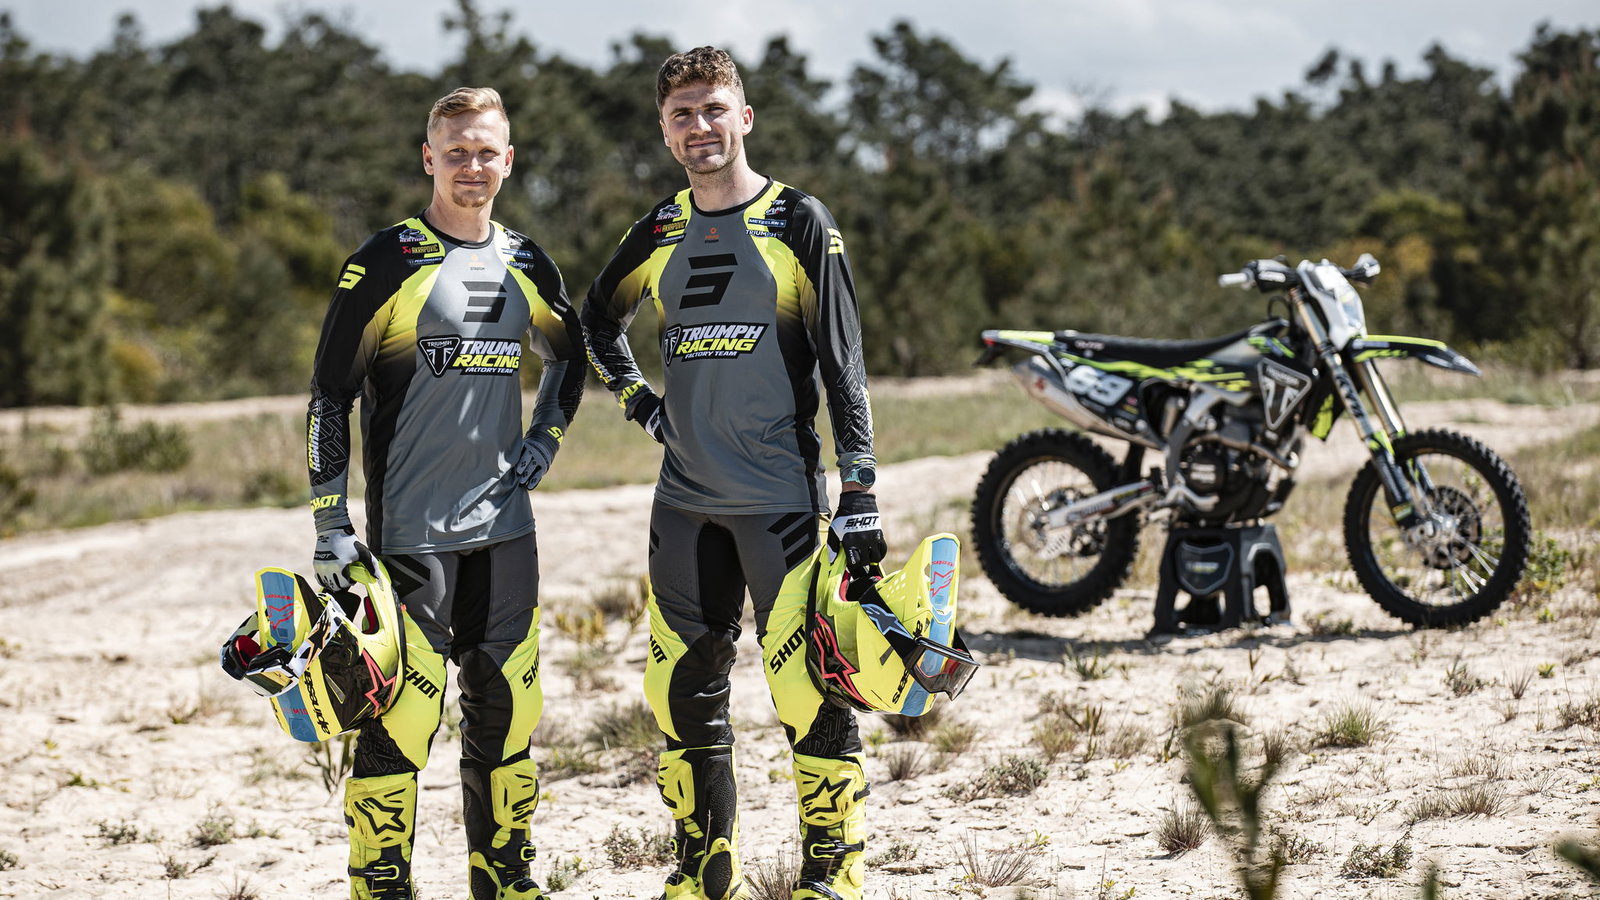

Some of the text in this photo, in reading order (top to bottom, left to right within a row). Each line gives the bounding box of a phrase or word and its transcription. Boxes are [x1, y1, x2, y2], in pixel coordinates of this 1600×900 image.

[682, 325, 764, 342] TRIUMPH
[676, 338, 757, 355] RACING
[452, 355, 519, 368] RACING
[312, 415, 321, 473] TRIUMPH
[845, 516, 879, 528] SHOT
[768, 623, 806, 675] SHOT
